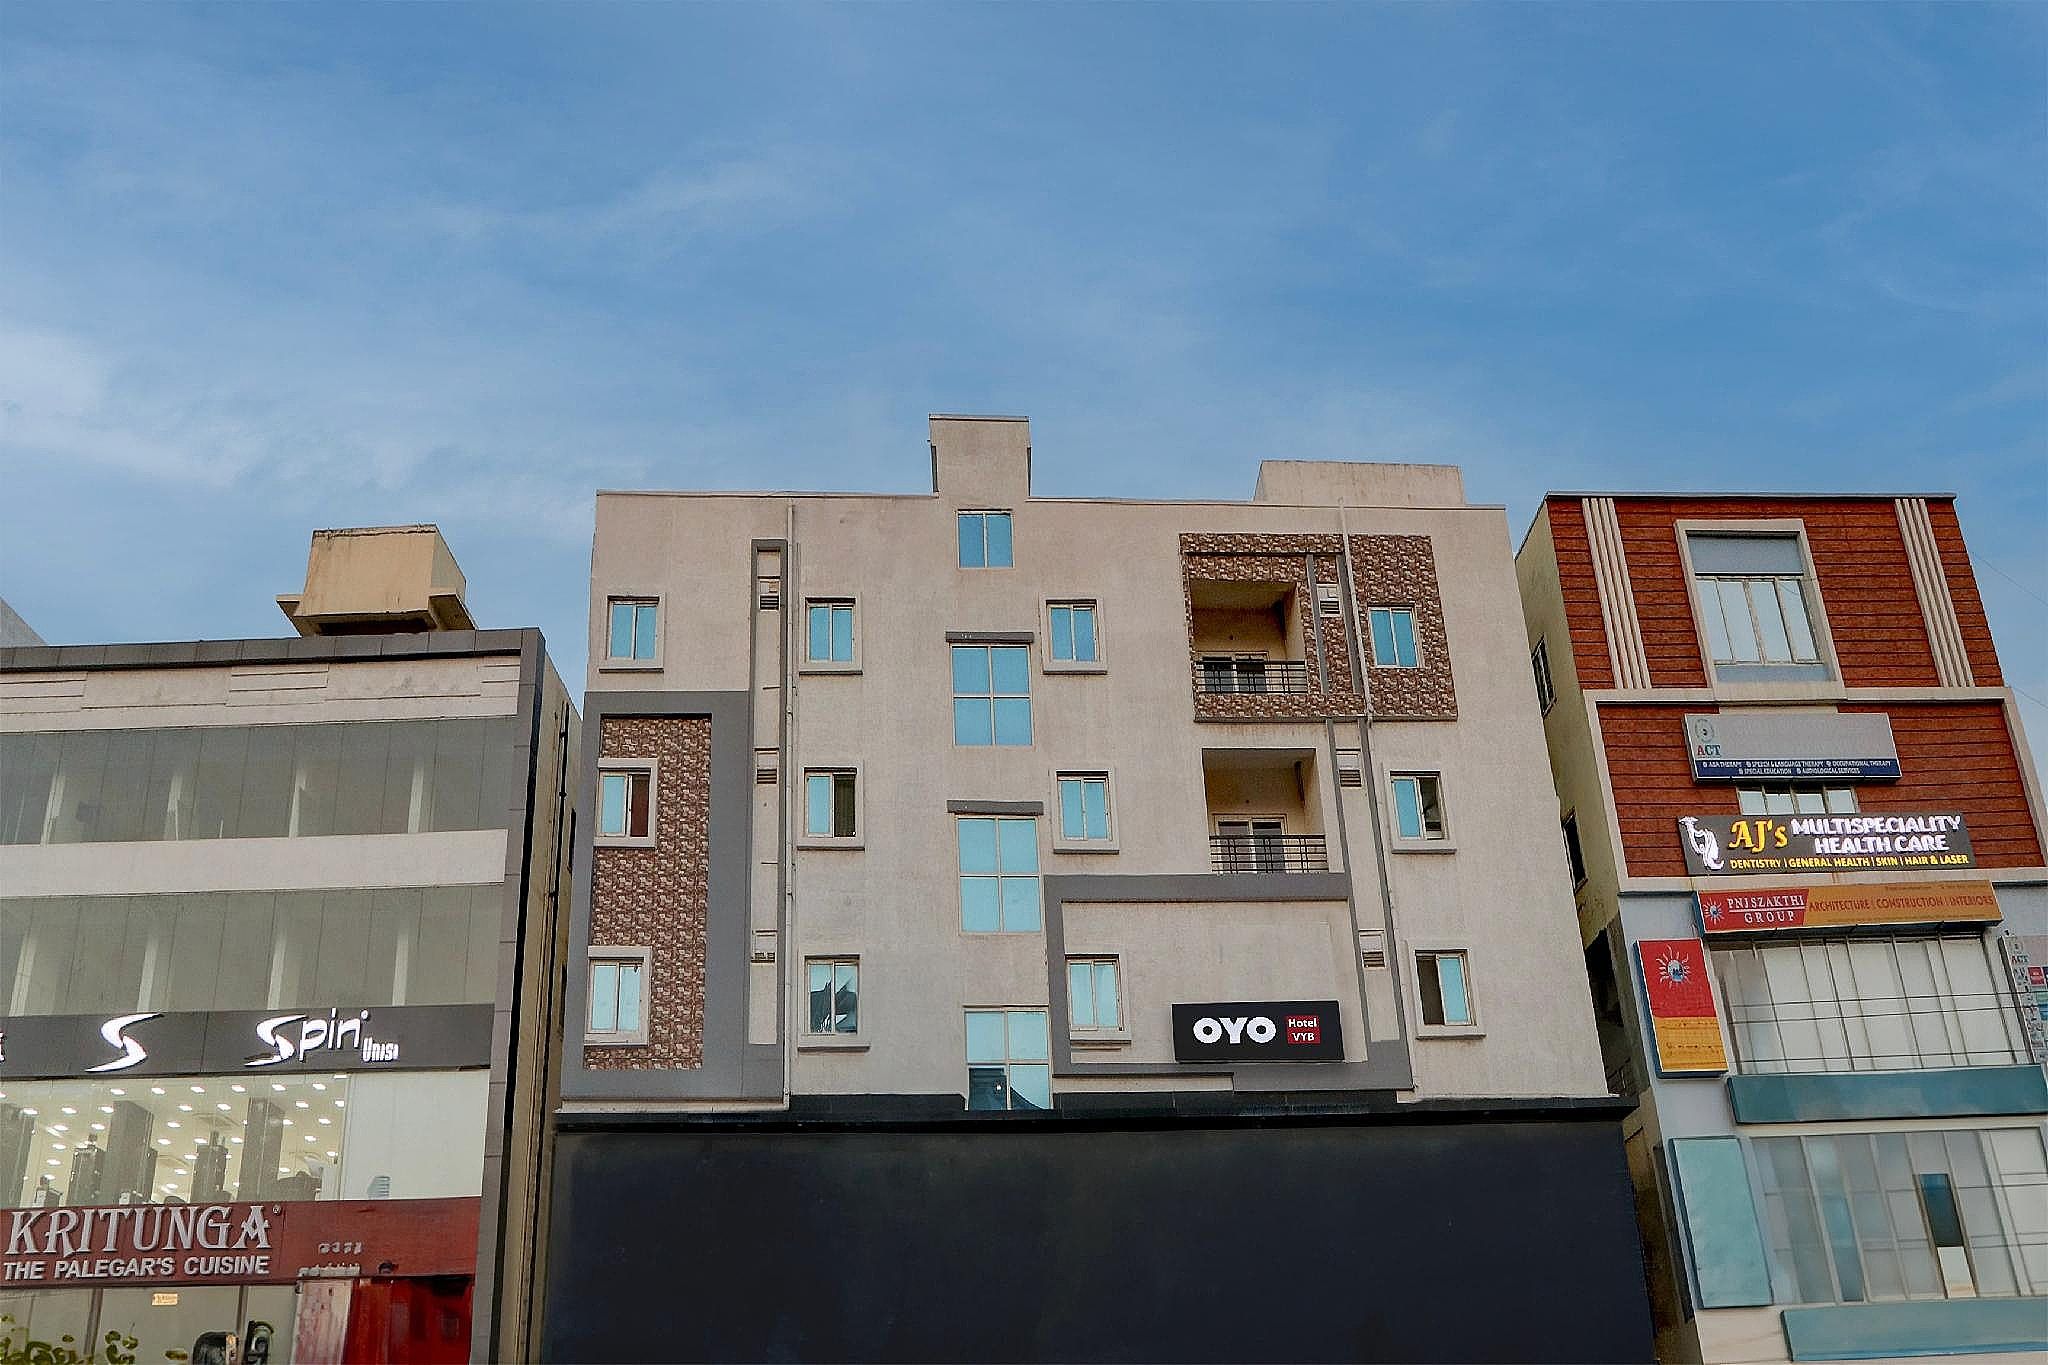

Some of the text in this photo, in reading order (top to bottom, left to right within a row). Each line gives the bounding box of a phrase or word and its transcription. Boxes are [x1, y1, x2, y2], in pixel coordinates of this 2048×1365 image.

[1697, 744, 1721, 756] ACT
[1729, 815, 1961, 853] AJ's MULTISPECIALITY
[1814, 834, 1950, 855] HEALTH CARE
[1730, 854, 1969, 869] DENTISTRY GENERAL HEALTH SKIN HAIR & LASER
[1809, 894, 1994, 912] ARCHITECTURE CONSTRUCTION INTERIORS
[1744, 910, 1794, 923] GROUP
[1193, 1016, 1277, 1044] OYO
[1288, 1018, 1318, 1028] Hotel
[244, 1007, 361, 1067] Spin
[1292, 1032, 1315, 1041] VYB
[6, 1205, 272, 1258] KRITUNGA
[4, 1255, 270, 1280] THE PALEGAR'S CUISINE
